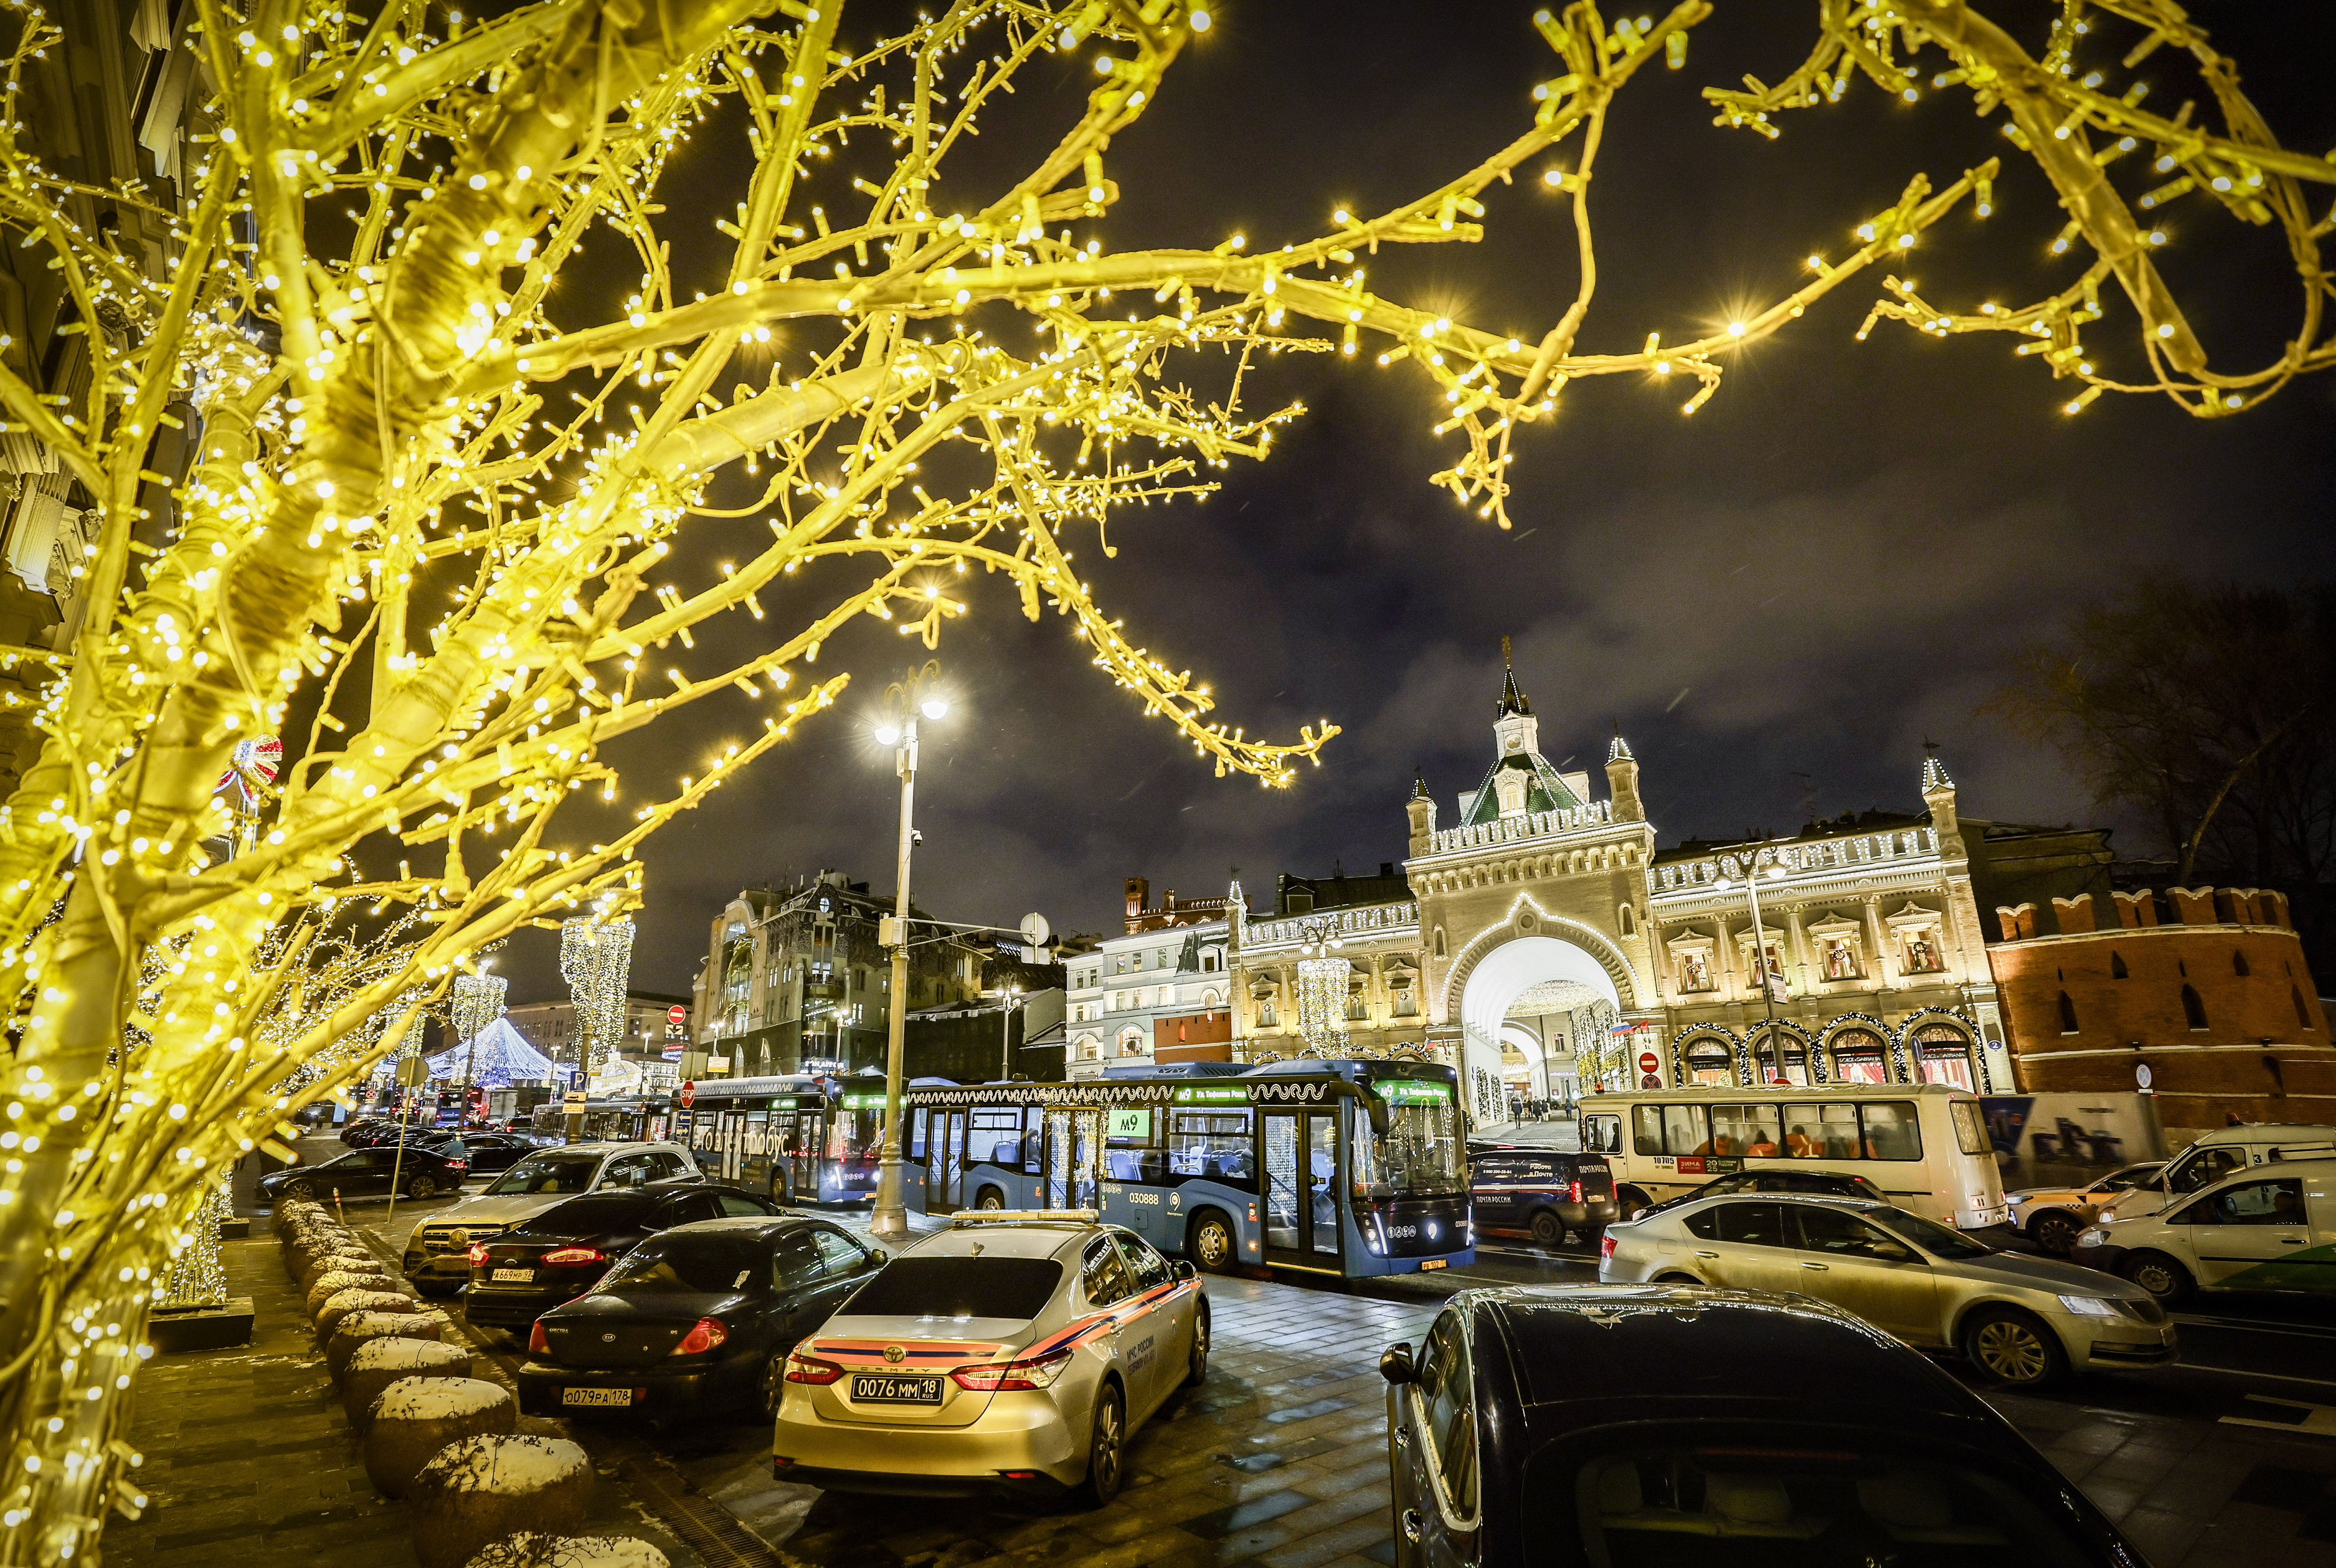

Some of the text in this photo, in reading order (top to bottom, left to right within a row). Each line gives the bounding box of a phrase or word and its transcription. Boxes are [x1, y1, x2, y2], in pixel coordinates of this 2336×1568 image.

[574, 1072, 584, 1089] P
[682, 1090, 694, 1098] STOP
[1129, 1192, 1159, 1205] 030888
[1127, 1346, 1137, 1362] МЧС
[922, 1380, 936, 1393] 18
